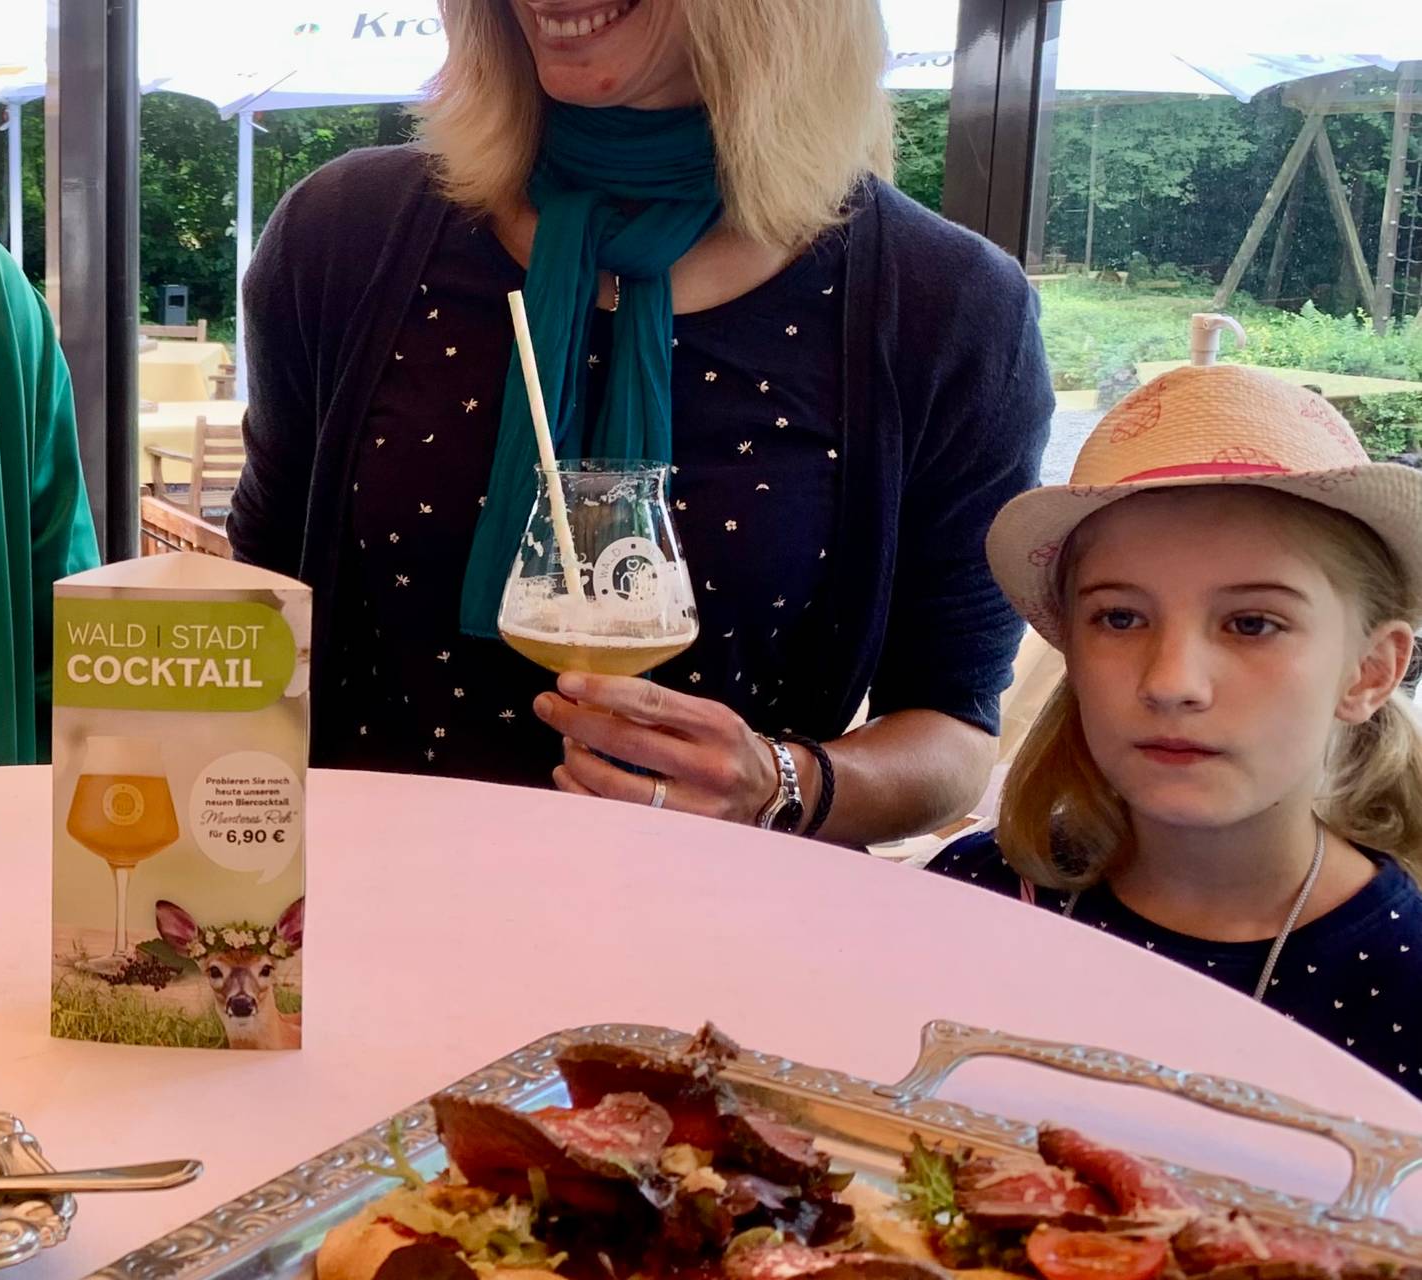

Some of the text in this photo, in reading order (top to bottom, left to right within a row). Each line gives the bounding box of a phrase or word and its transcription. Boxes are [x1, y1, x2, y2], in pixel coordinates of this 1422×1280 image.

[67, 621, 146, 648] WALD
[171, 625, 264, 650] STADT
[67, 654, 263, 688] COCKTAIL
[205, 776, 290, 785] Probieren Sie noch
[215, 787, 280, 796] heute unseren
[205, 798, 289, 807] neuen Biercocktail
[209, 829, 285, 846] für 6,90 €
